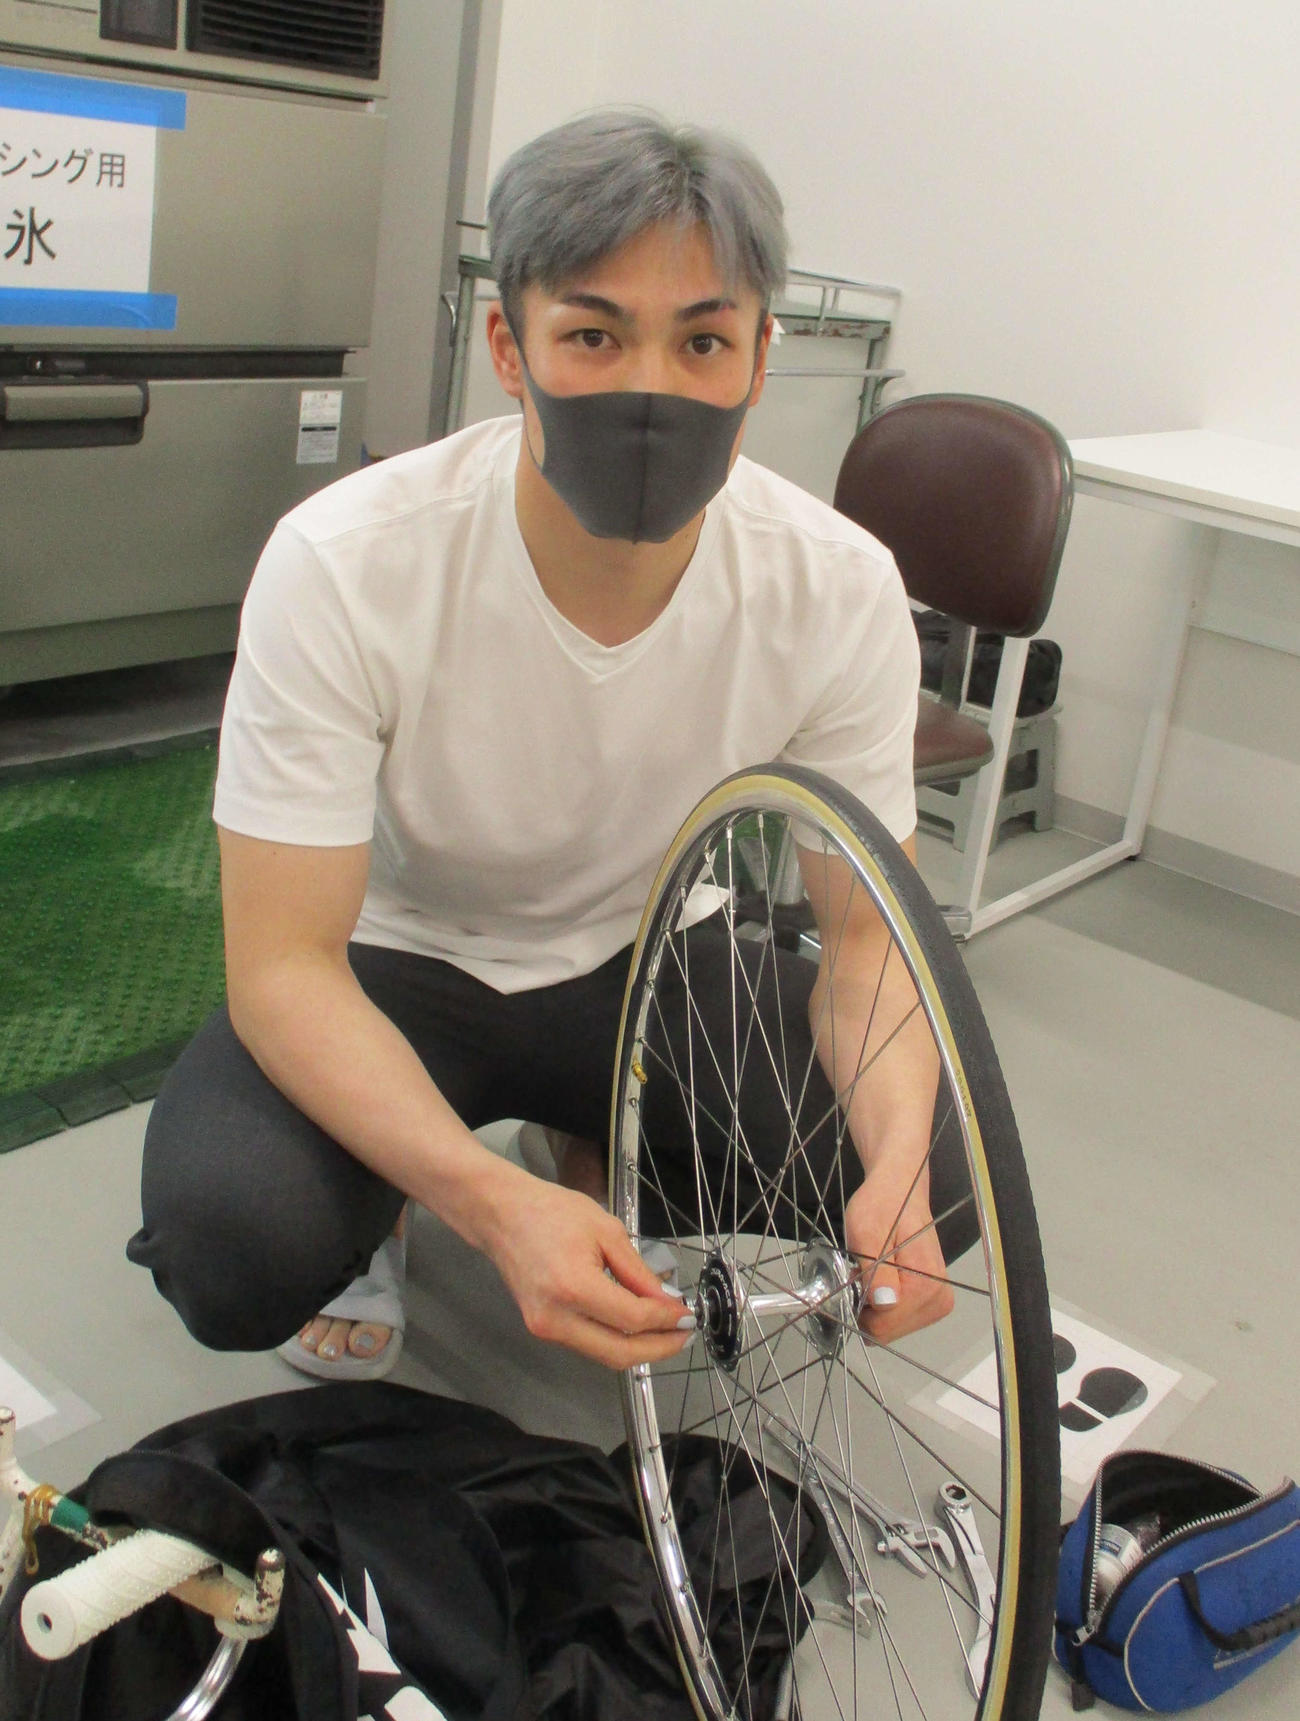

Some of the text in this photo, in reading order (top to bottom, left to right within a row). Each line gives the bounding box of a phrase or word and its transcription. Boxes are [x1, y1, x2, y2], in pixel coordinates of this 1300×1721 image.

[0, 142, 125, 188] シング用
[4, 206, 56, 266] 氷
